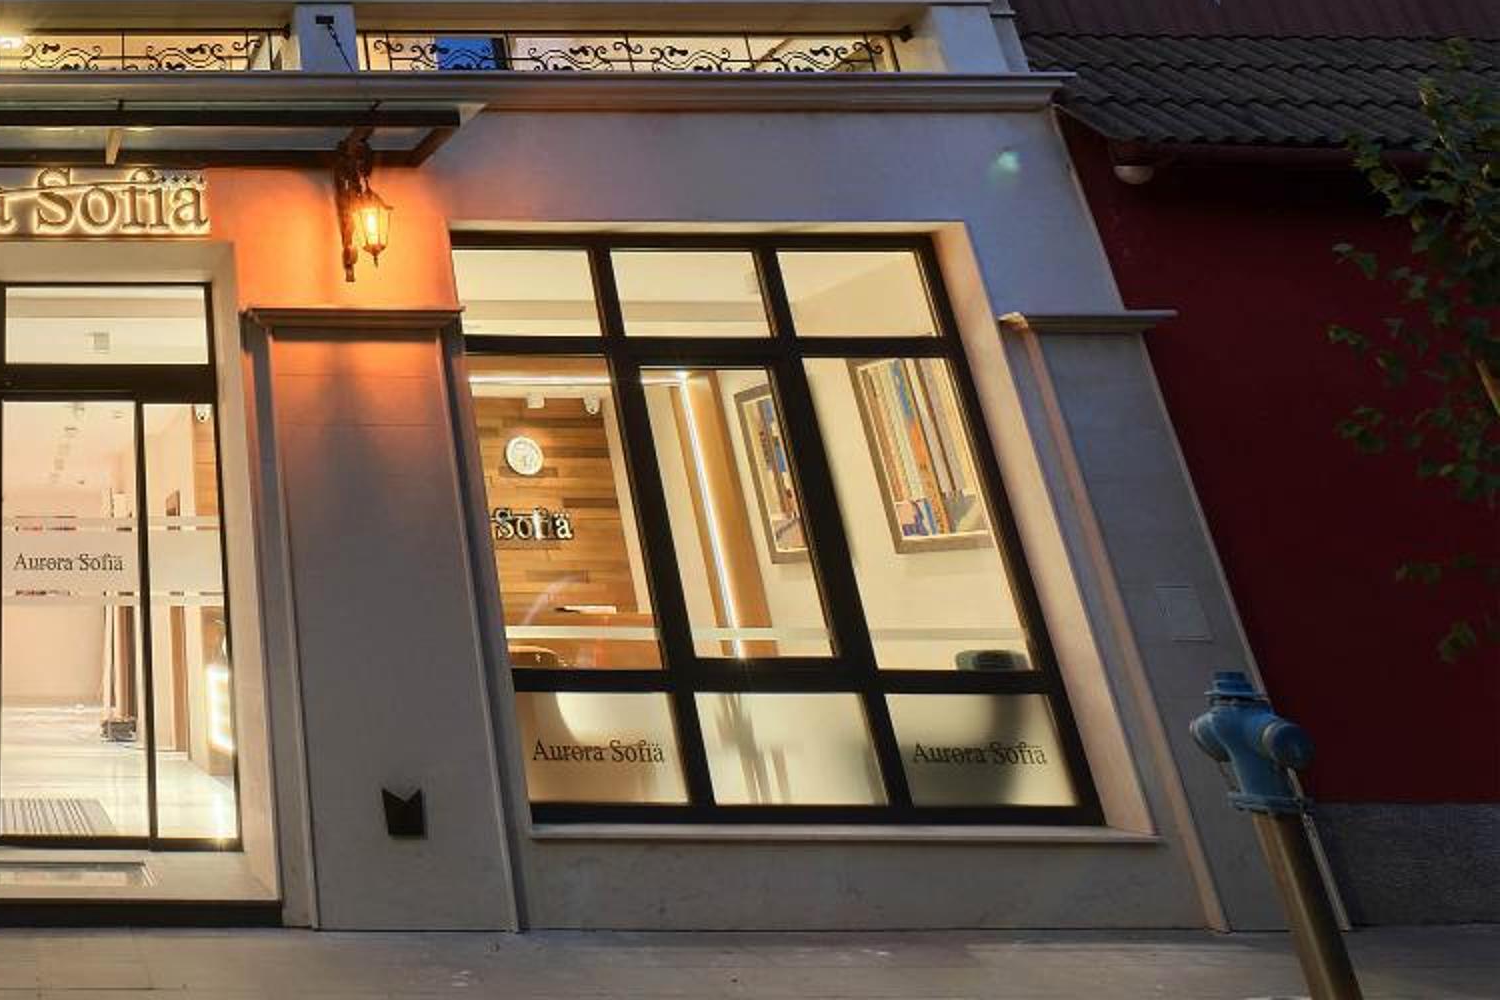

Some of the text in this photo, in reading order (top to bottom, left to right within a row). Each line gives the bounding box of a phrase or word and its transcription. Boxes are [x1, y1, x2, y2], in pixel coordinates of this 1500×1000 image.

[34, 166, 208, 230] Sofia
[494, 507, 574, 540] Sofia
[14, 553, 124, 572] Aurora Sofia
[533, 740, 664, 762] Aurora Sofia
[913, 742, 1047, 765] Aurora Sofia
